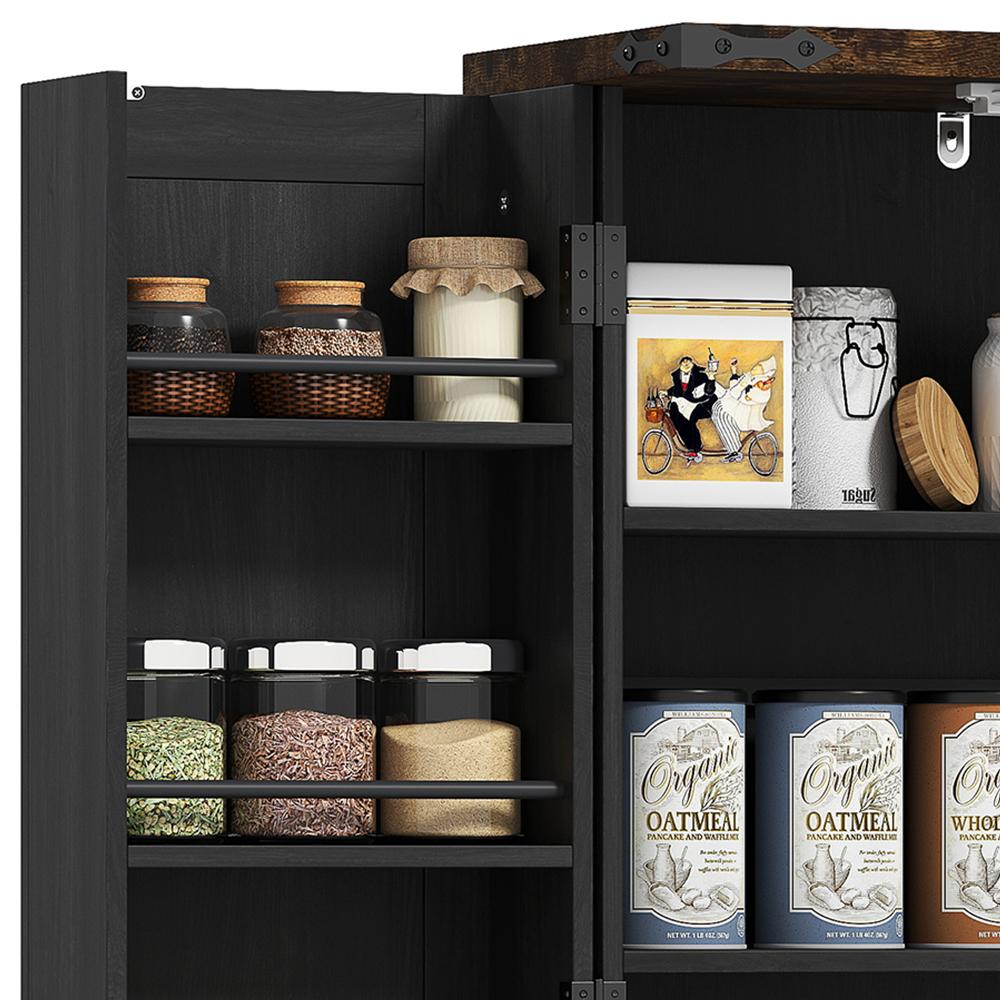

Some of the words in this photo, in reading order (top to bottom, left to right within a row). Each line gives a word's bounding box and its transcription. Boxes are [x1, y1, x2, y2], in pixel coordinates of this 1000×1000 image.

[642, 737, 738, 809] Organic
[801, 737, 898, 809] Organic
[646, 811, 739, 831] OATMEAL
[806, 811, 897, 832] OATMEAL
